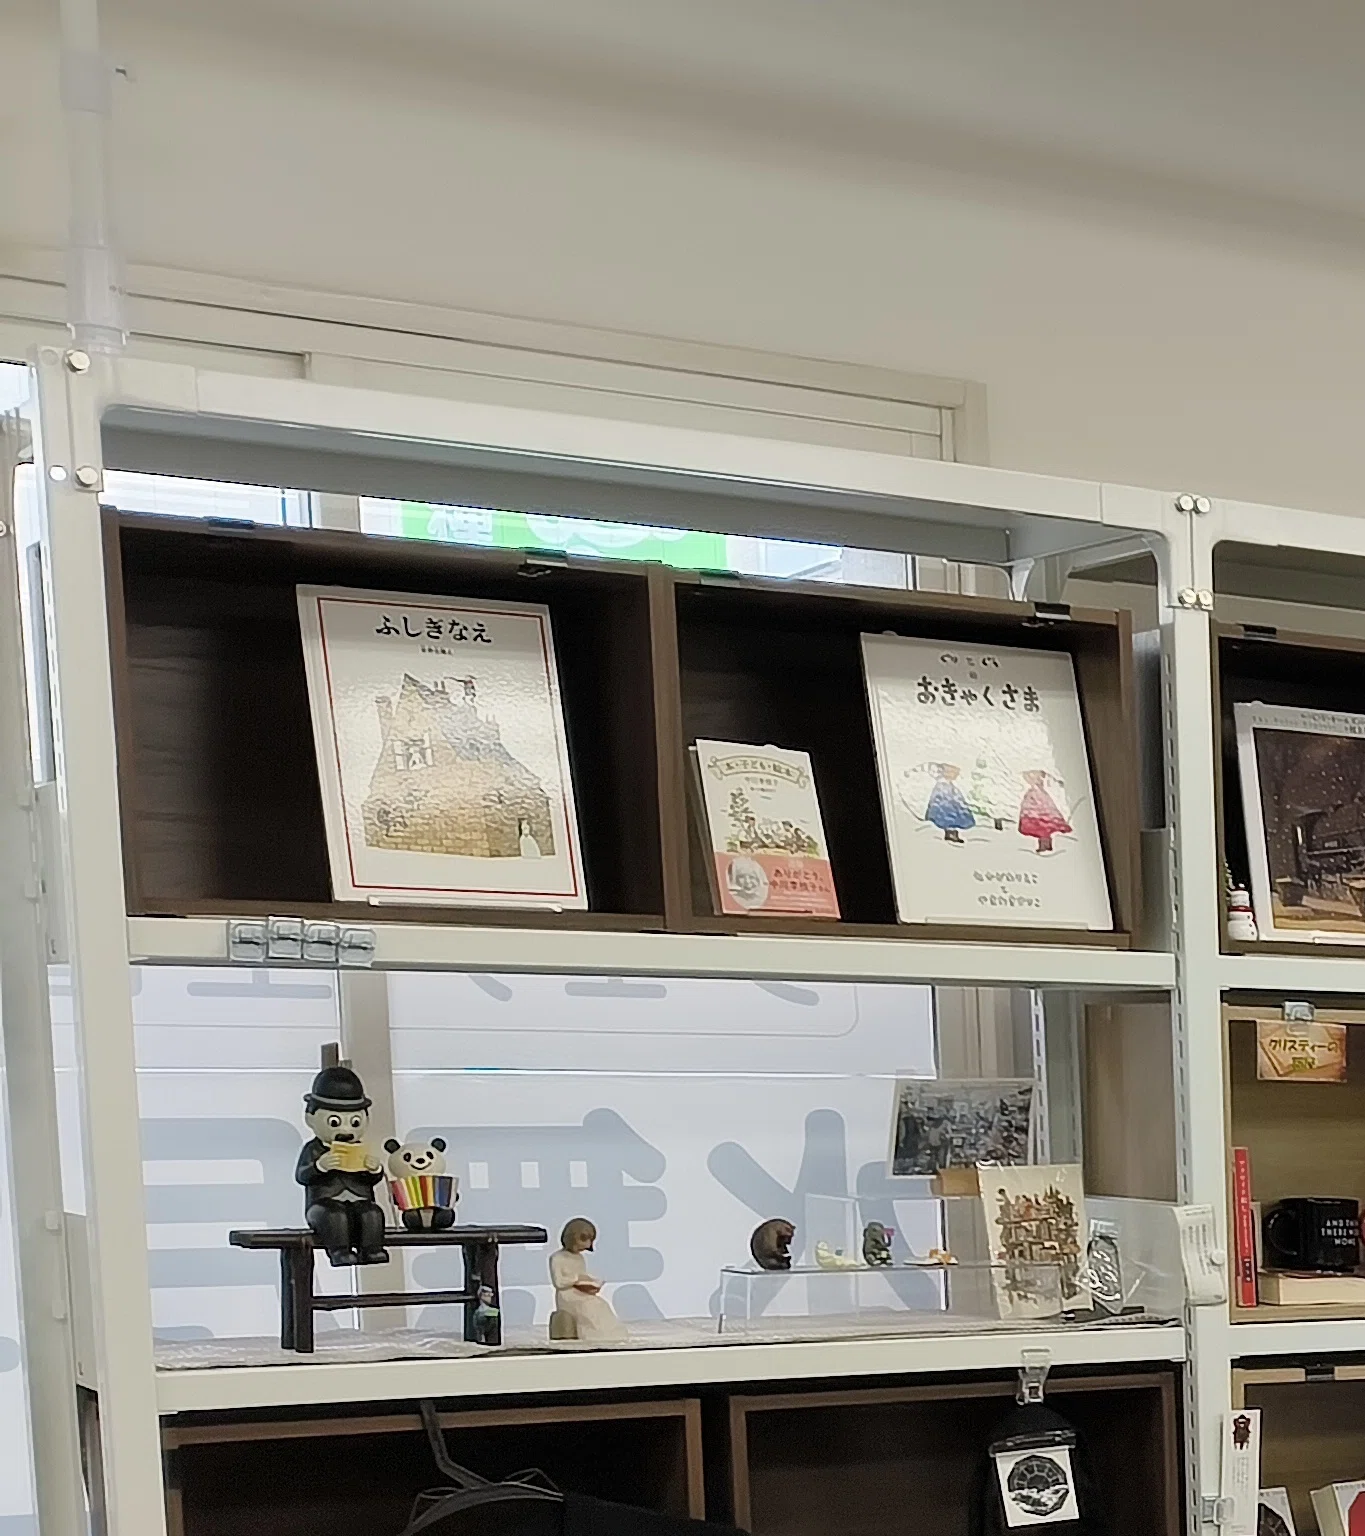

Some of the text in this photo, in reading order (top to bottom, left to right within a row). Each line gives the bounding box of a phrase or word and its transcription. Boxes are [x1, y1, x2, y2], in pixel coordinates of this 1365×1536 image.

[375, 614, 493, 645] ふしぎなえ
[917, 675, 1040, 713] おきゃくさま
[1268, 1038, 1340, 1054] クリスティーの
